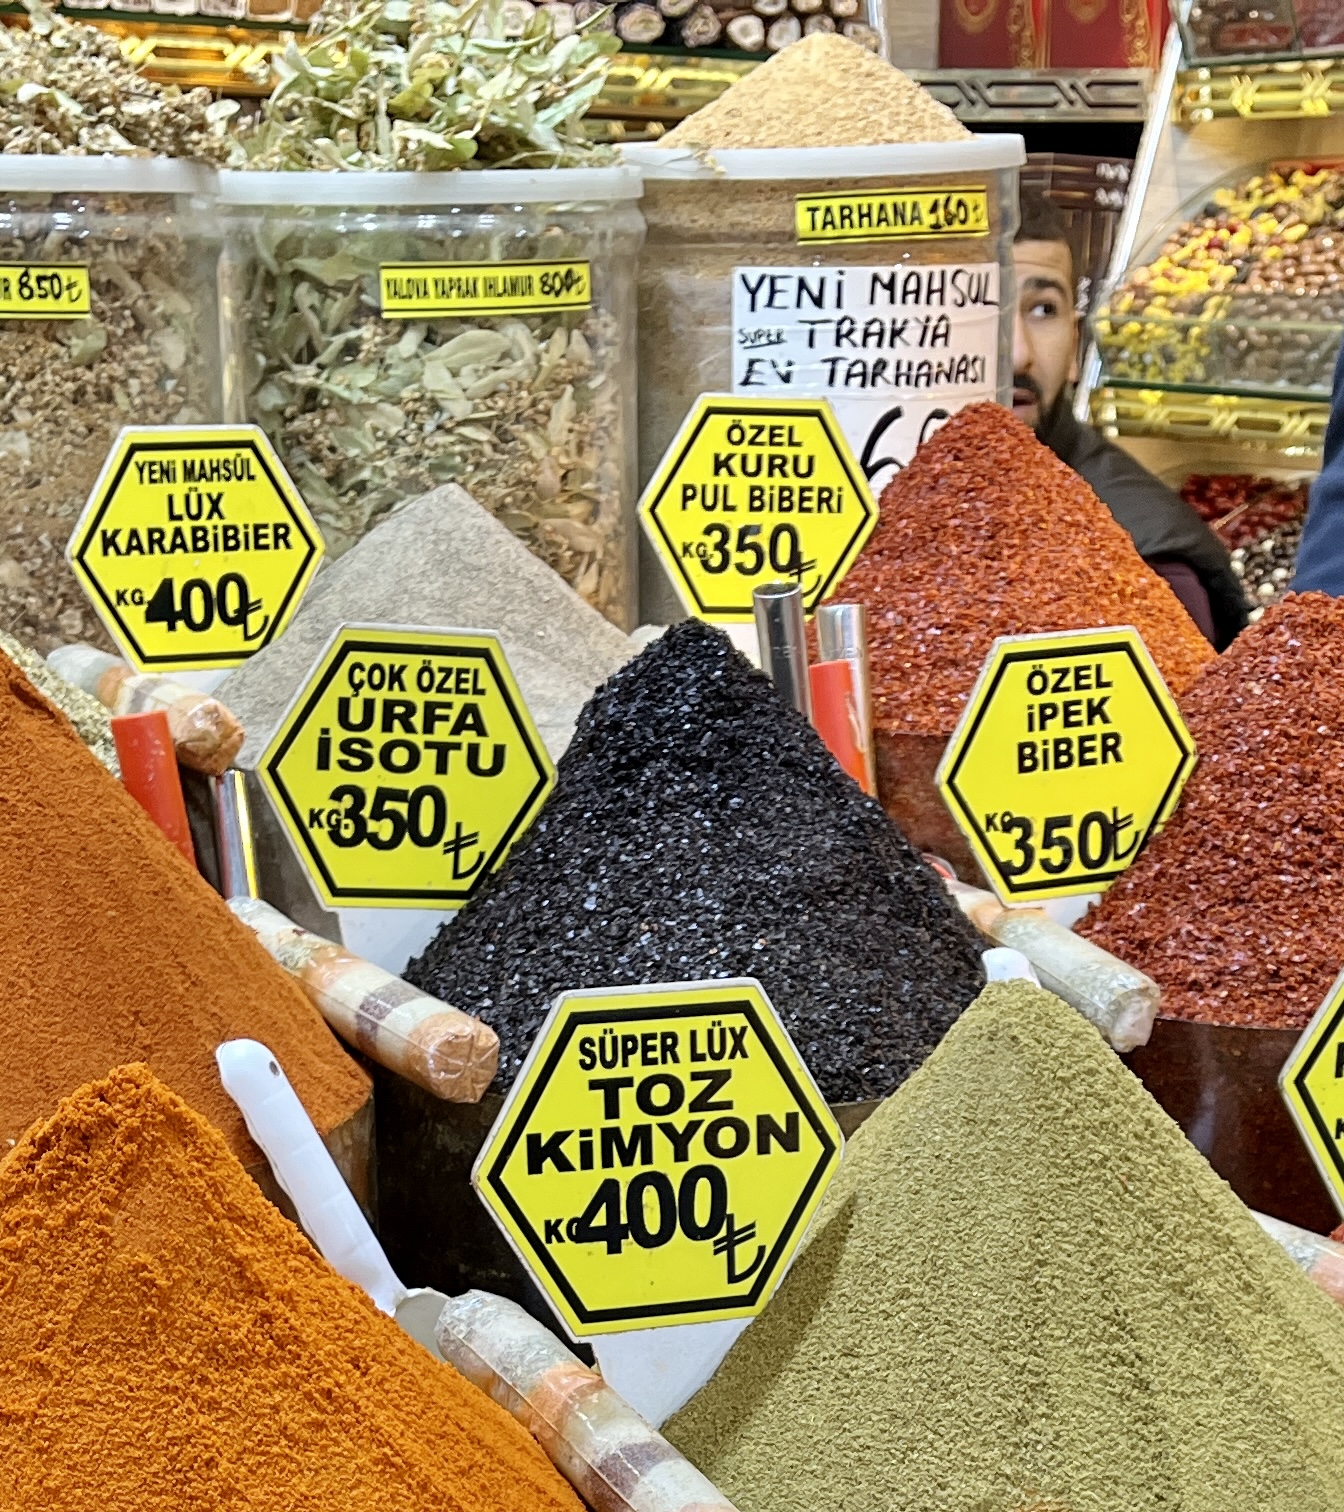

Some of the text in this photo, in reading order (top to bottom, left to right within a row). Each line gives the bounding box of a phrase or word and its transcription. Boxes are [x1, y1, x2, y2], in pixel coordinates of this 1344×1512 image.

[807, 201, 923, 231] TARHANA
[798, 314, 951, 349] TRAKYA
[727, 419, 802, 447] ÖZEL
[183, 453, 256, 482] MAHSÜL
[714, 453, 815, 478] KURU
[168, 487, 225, 521] LÜX
[681, 484, 737, 512] PUL
[348, 660, 486, 697] ÇOK ÖZEL
[1027, 663, 1113, 695] ÖZEL
[338, 696, 489, 737] URFA
[578, 1021, 749, 1071] SÜPER LÜX
[588, 1069, 734, 1121] TOZ
